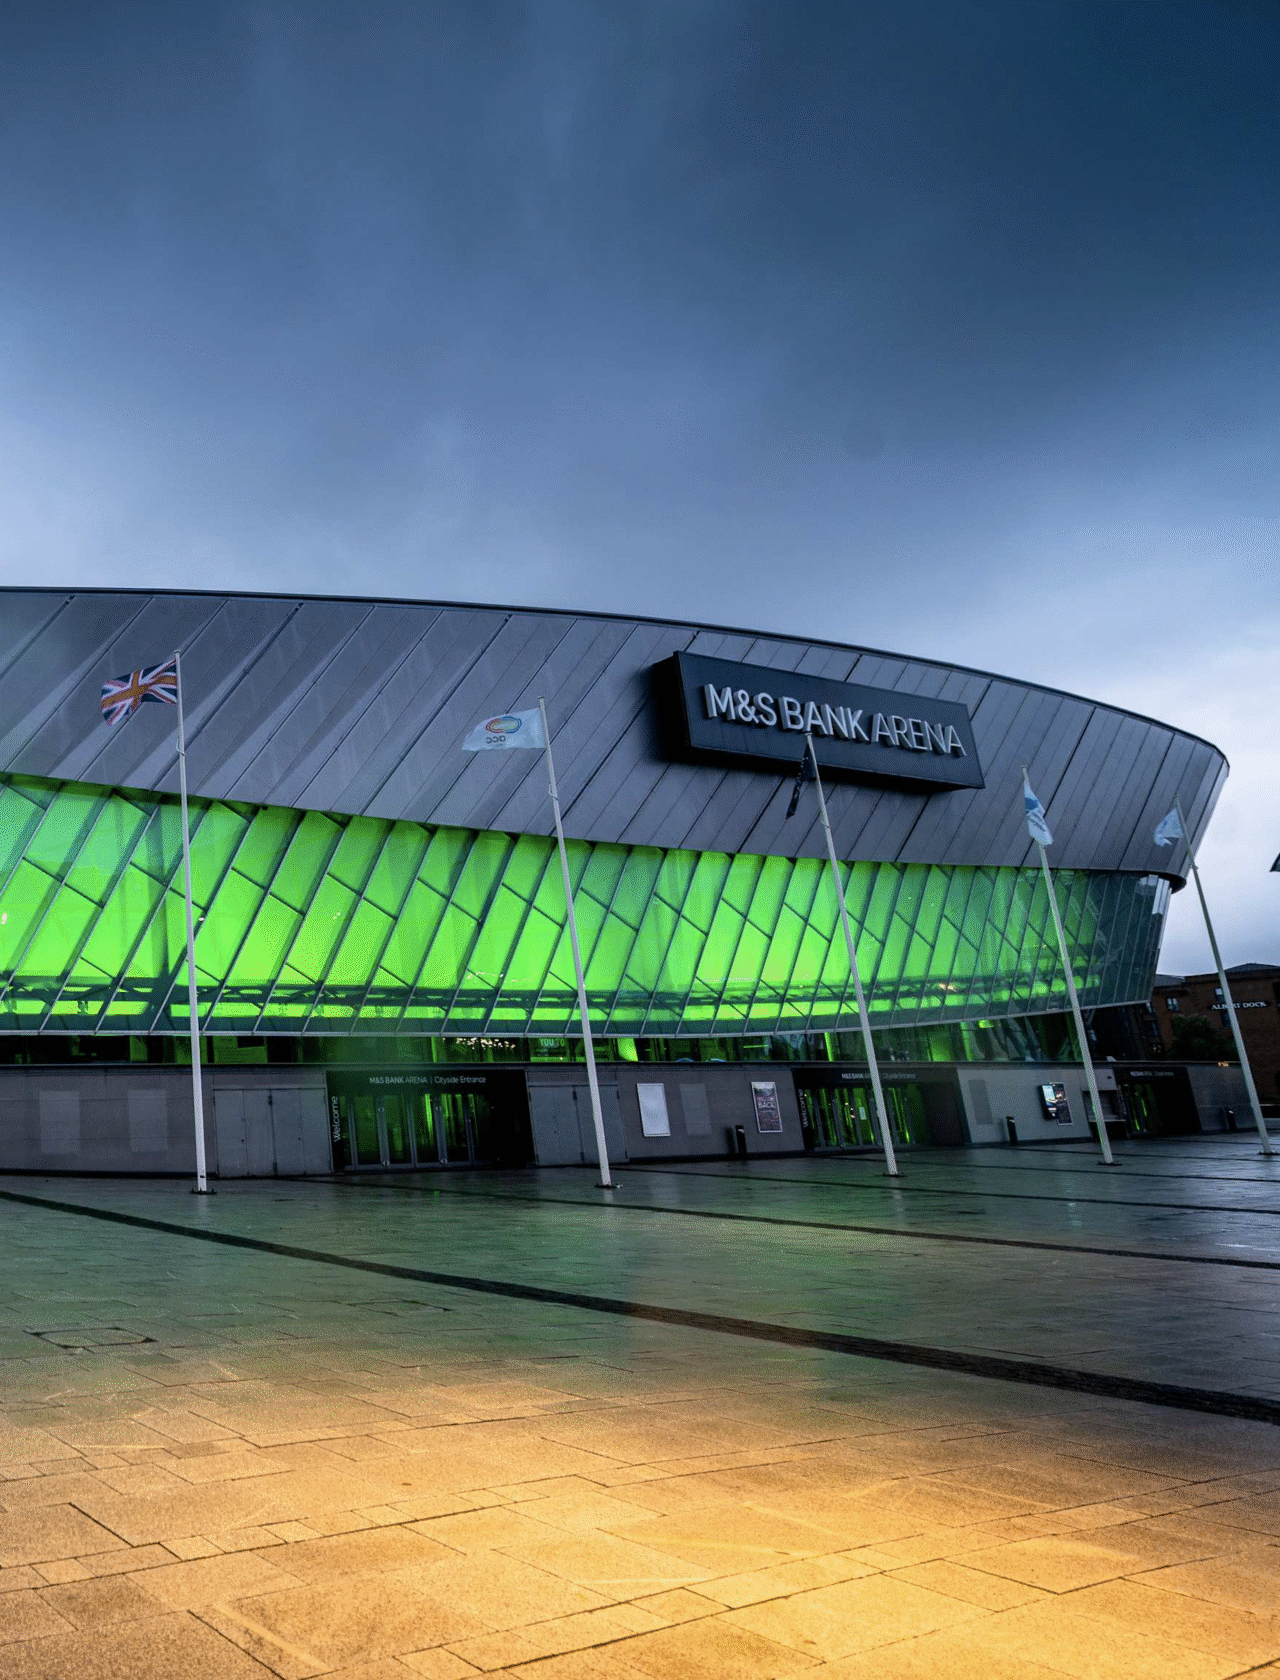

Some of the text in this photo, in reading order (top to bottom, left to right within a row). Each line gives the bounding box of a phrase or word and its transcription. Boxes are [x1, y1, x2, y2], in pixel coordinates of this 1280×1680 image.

[703, 683, 968, 757] M&S BANK ARENA
[1211, 1001, 1267, 1010] ALBRT DOCK
[369, 1076, 487, 1085] M&S BANK ARENA Cityside Entrance
[332, 1096, 340, 1142] Welcome
